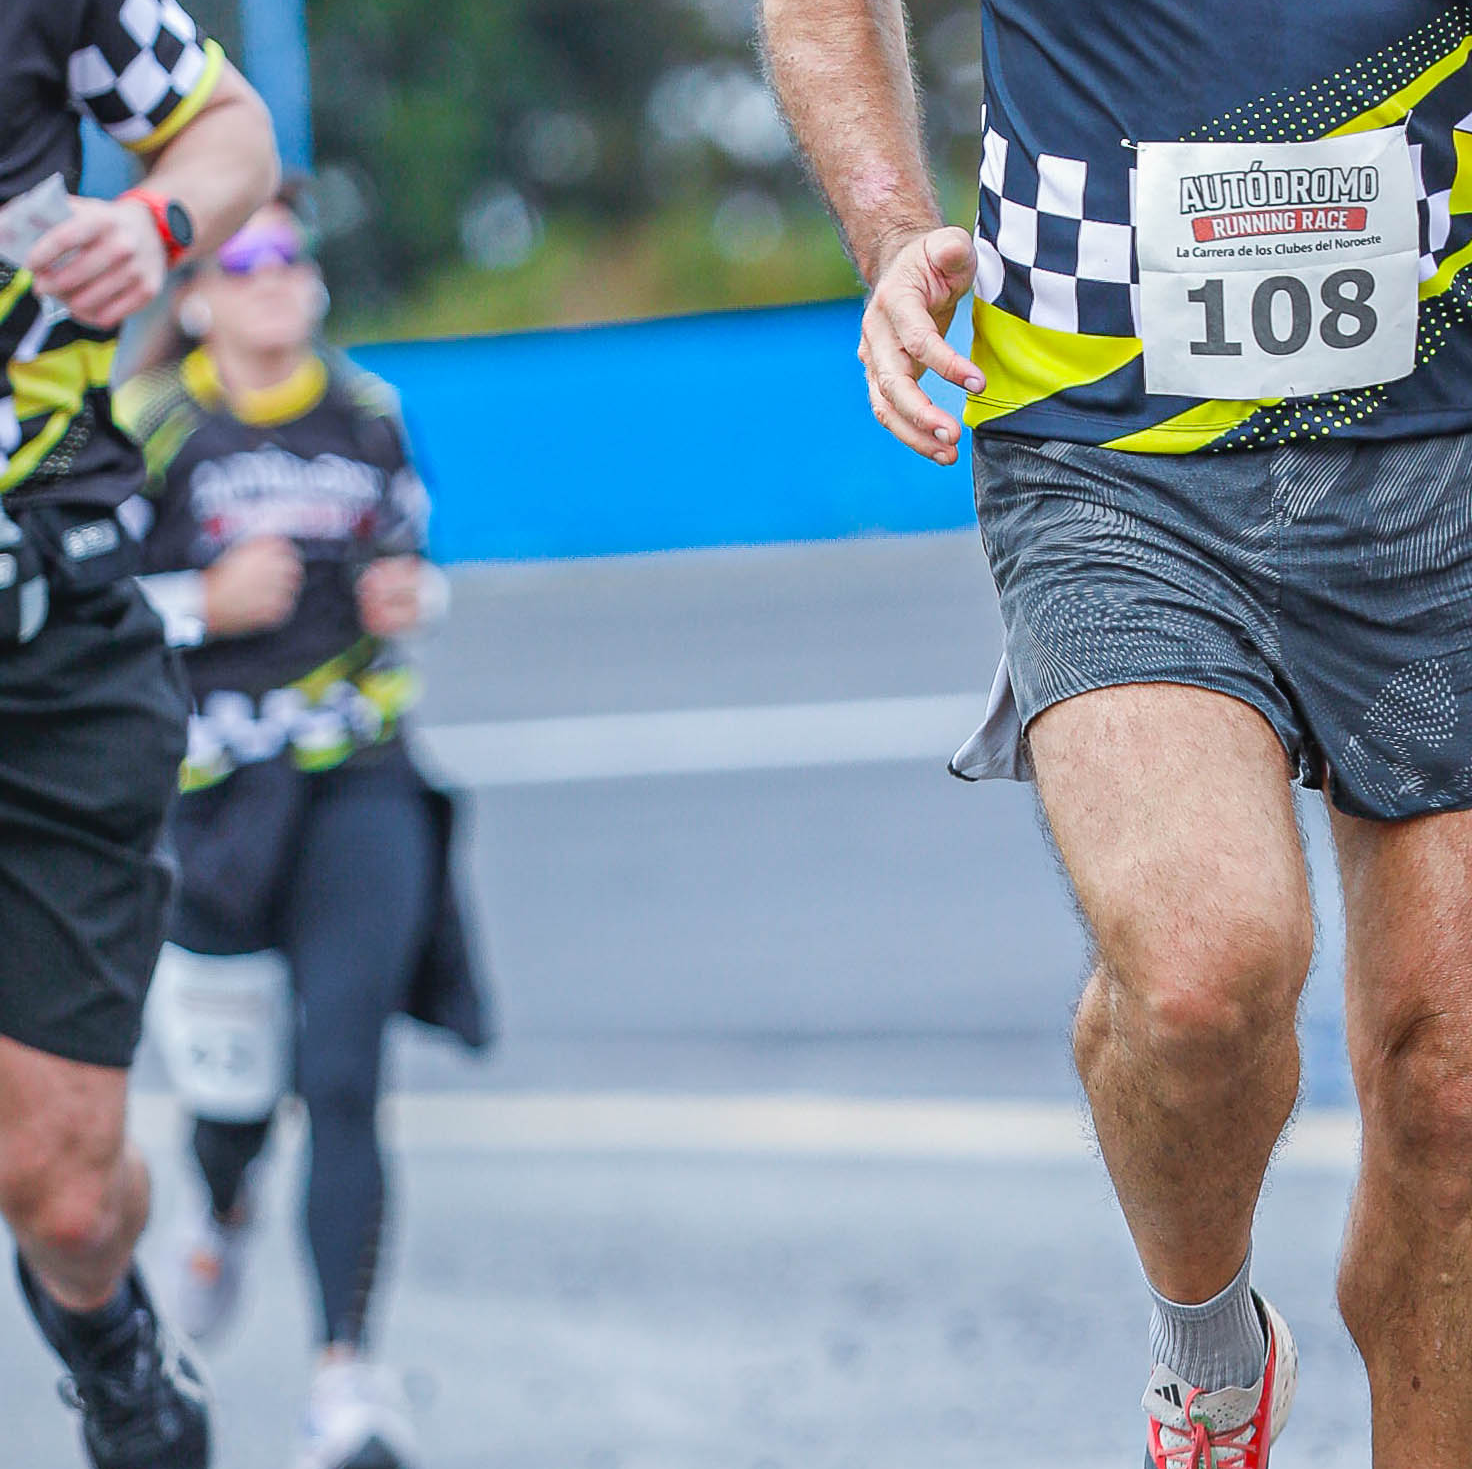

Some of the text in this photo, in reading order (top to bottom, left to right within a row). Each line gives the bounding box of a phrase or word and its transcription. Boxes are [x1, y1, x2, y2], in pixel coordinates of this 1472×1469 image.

[1180, 160, 1379, 214] AUTÓDROMO
[1211, 210, 1348, 238] RUNNING RACE
[1176, 235, 1382, 258] La Carrera de los Clubes del Noroeste
[1187, 268, 1378, 357] 108
